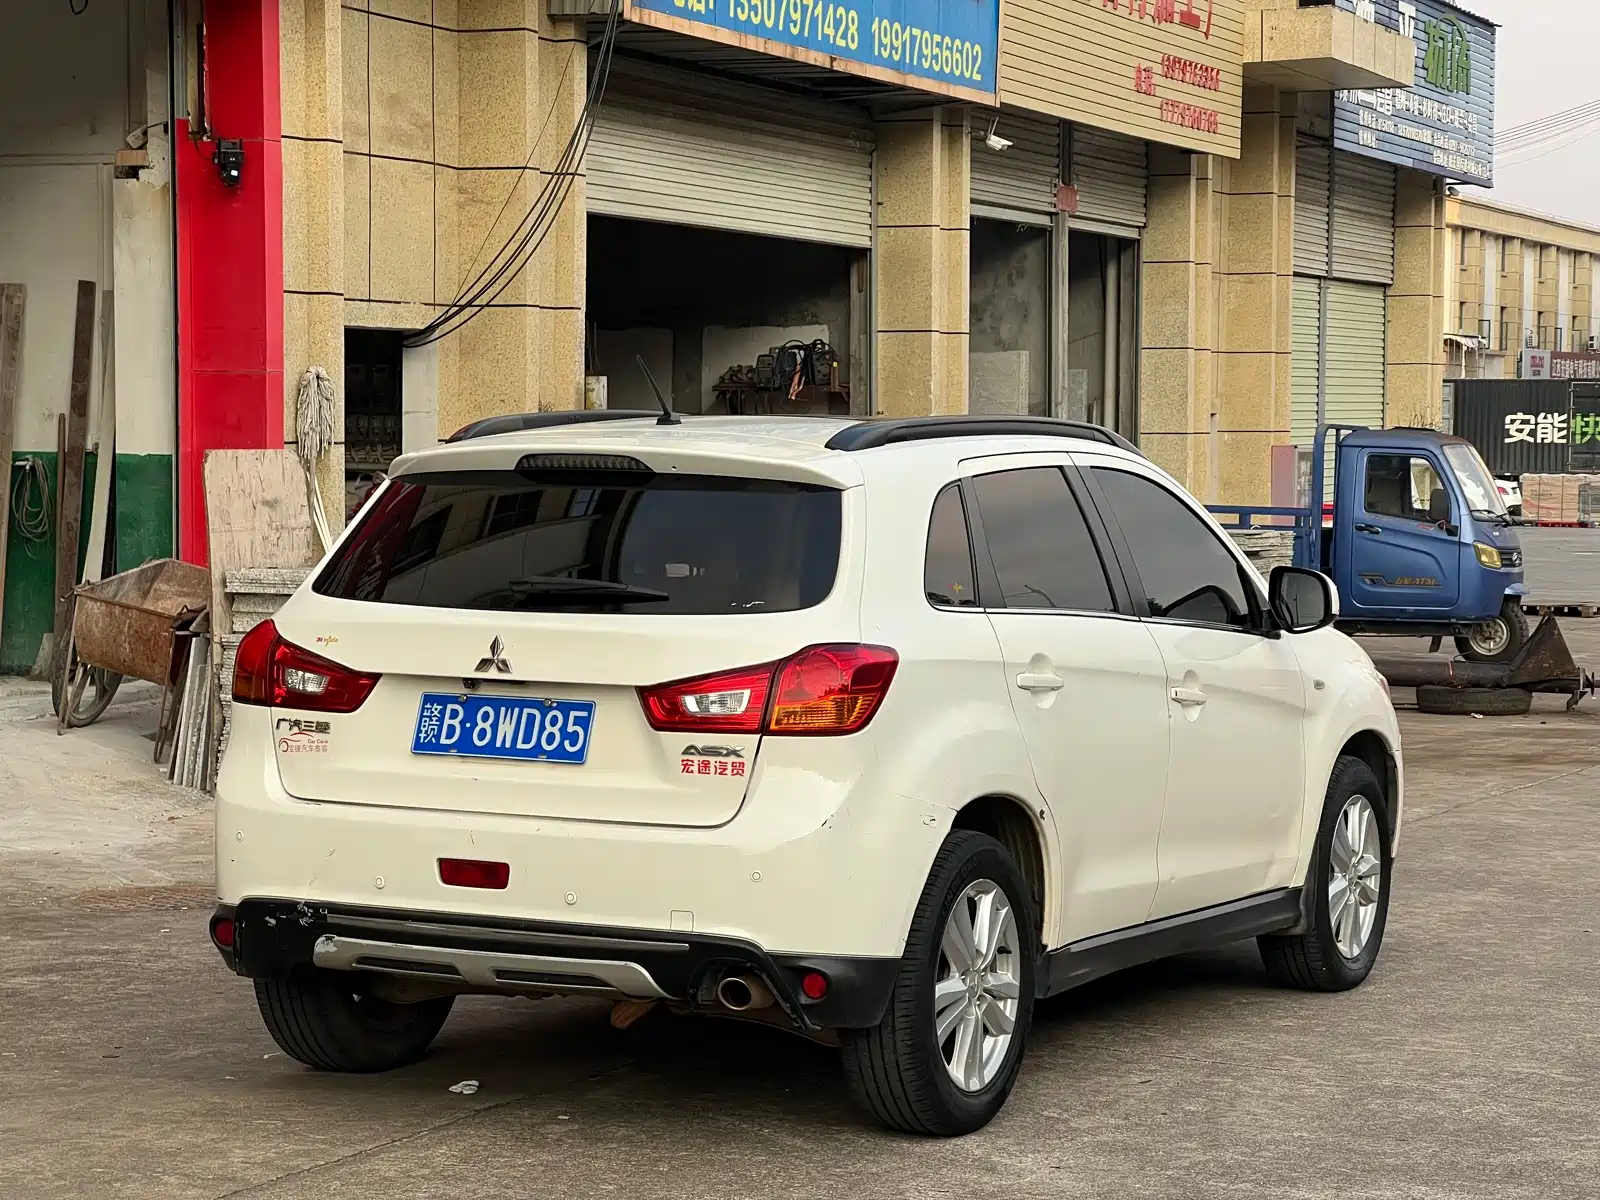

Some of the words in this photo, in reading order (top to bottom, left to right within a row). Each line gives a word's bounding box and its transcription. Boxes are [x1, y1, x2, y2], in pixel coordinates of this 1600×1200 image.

[871, 16, 983, 81] 19917956602
[418, 703, 589, 753] 赣B·8WD85
[680, 744, 746, 759] ASX
[680, 759, 746, 777] 宏途汽贸
